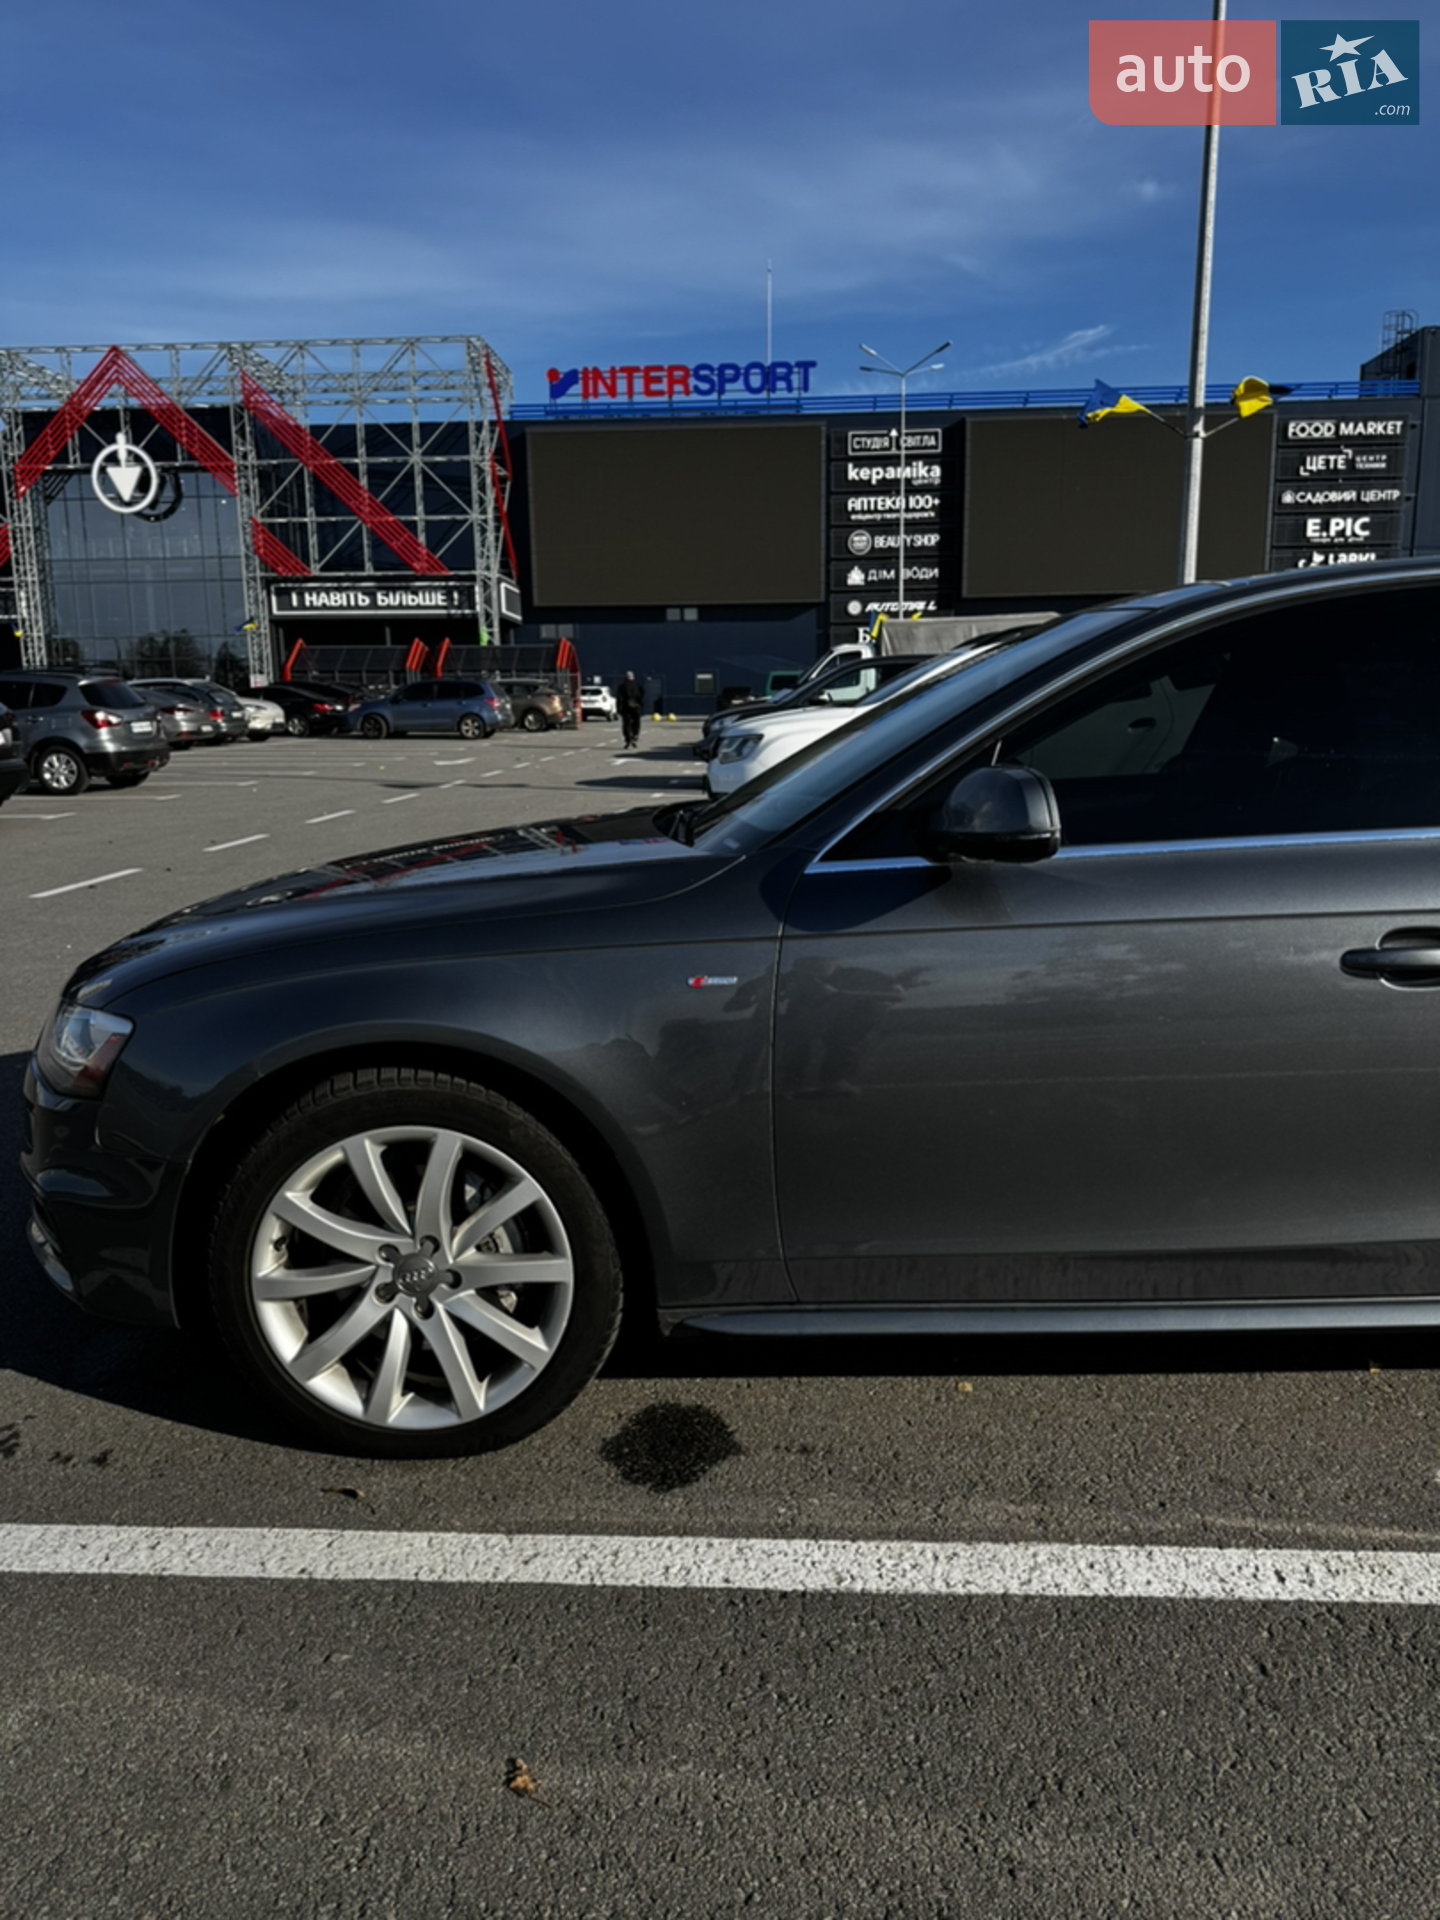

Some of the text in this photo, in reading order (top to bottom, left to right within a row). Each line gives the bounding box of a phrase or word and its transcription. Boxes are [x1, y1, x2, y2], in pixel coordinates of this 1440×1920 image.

[580, 360, 818, 399] INTERSPORT
[1287, 420, 1403, 439] FOOD MARKET
[1305, 454, 1347, 471] ЦЕТЕ
[847, 496, 906, 511] АПТЕКА
[1295, 488, 1401, 504] САДОВИЙ ЦЕНТР
[1305, 516, 1371, 538] E.PIC
[912, 533, 940, 547] SHOP
[867, 568, 895, 581] ДІМ
[305, 591, 370, 607] НАВІТЬ
[376, 590, 447, 607] БІЛЬШЕ
